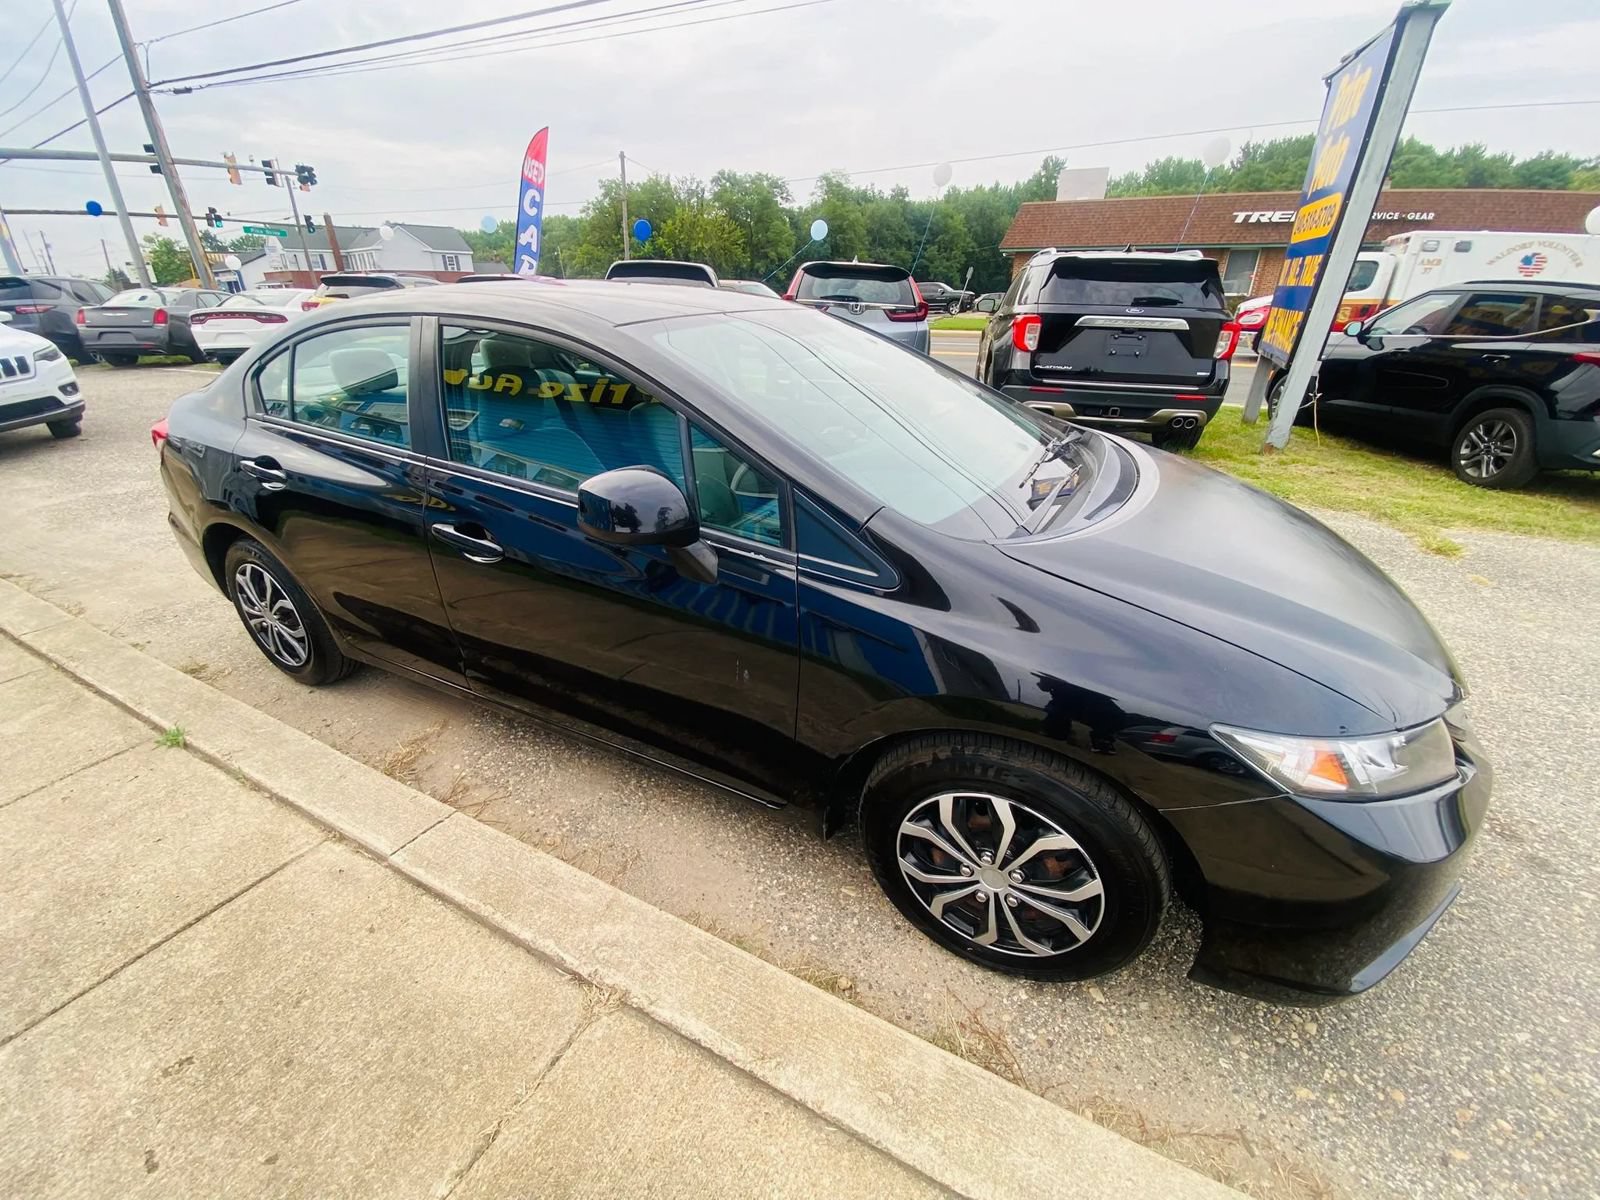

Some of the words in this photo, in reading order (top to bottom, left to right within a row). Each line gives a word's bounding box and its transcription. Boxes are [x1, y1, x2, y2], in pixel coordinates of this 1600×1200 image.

[523, 157, 545, 185] USED
[1232, 210, 1297, 224] TRE
[1371, 212, 1400, 220] RVICE
[1407, 212, 1435, 220] GEAR
